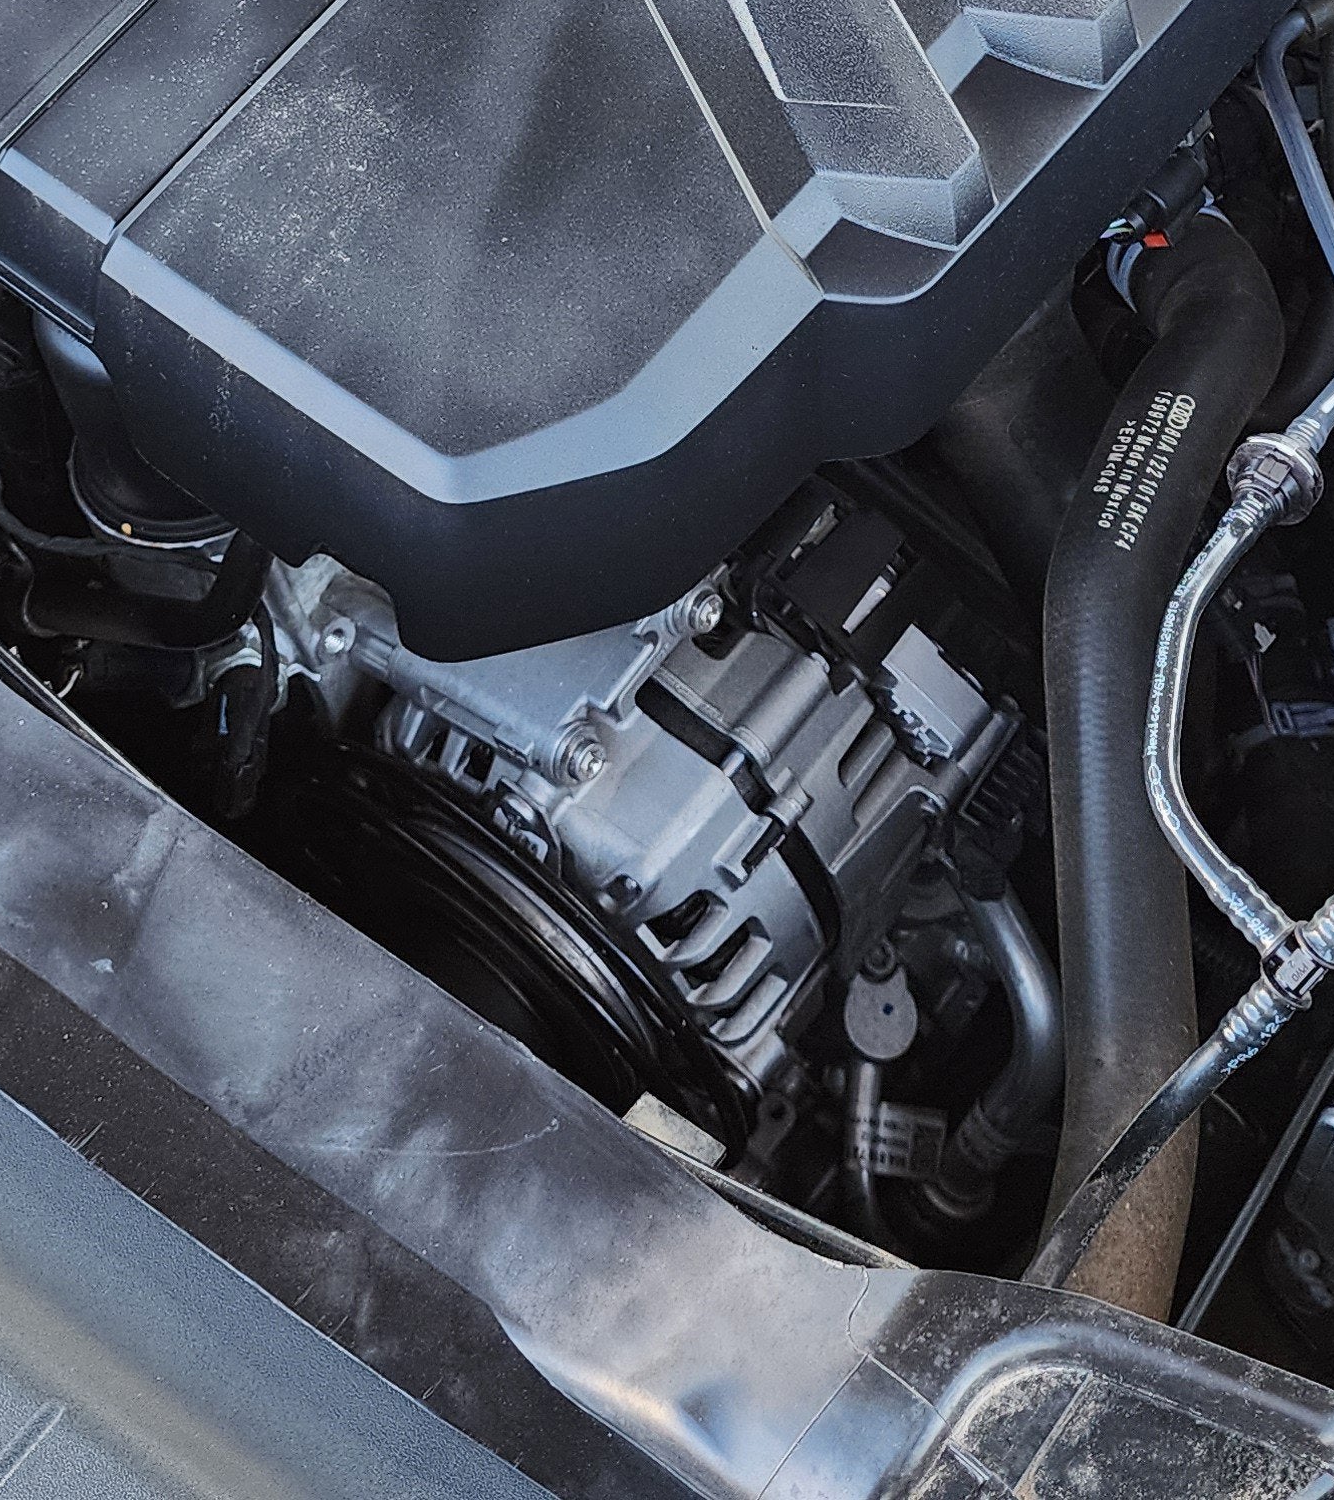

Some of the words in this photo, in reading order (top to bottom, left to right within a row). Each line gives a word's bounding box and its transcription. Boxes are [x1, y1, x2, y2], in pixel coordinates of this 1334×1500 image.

[1140, 391, 1174, 434] 159972
[1125, 434, 1154, 467] Made
[1156, 426, 1182, 453] 80A
[1119, 468, 1138, 481] in
[1145, 453, 1169, 479] 122
[1135, 478, 1159, 504] 101
[1098, 483, 1132, 529] Mexico
[1125, 501, 1148, 525] BK
[1114, 521, 1139, 551] CF4
